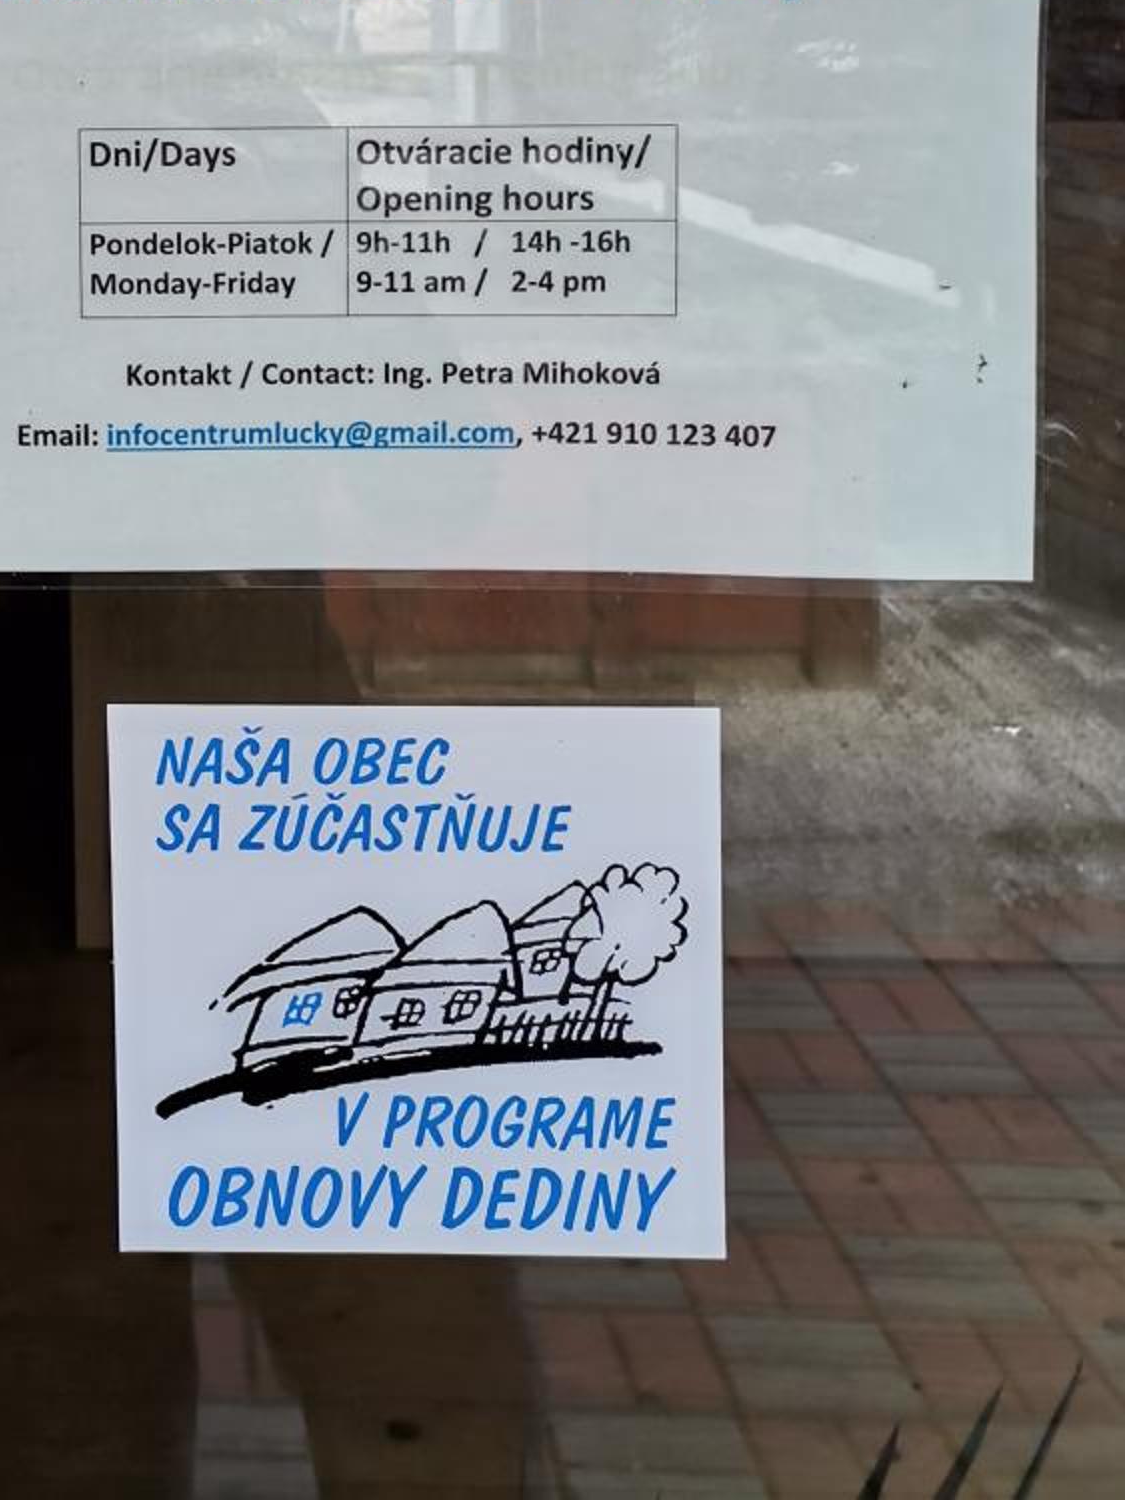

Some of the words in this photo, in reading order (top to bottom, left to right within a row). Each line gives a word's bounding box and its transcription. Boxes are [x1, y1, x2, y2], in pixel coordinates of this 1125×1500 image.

[89, 138, 236, 173] Dni/Days
[356, 137, 513, 167] Otváracie
[523, 134, 651, 171] hodiny/
[356, 185, 493, 218] Opening
[503, 182, 595, 211] hours
[89, 230, 313, 258] Pondelok-Piatok
[321, 230, 334, 259] /
[356, 229, 451, 255] 9h-11h
[475, 229, 487, 258] /
[511, 229, 562, 255] 14h
[570, 229, 631, 255] -16h
[89, 271, 296, 302] Monday-Friday
[356, 270, 414, 295] 9-11
[423, 276, 466, 295] am
[475, 269, 488, 298] /
[511, 269, 555, 294] 2-4
[564, 274, 607, 299] pm
[125, 362, 232, 388] Kontakt
[240, 362, 254, 391] /
[261, 362, 375, 388] Contact:
[384, 361, 432, 392] Ing.
[441, 362, 513, 387] Petra
[523, 360, 660, 387] Mihoková
[17, 423, 100, 449] Email:
[106, 421, 523, 453] infocentrumlucky@gmail.com,
[531, 422, 597, 446] +421
[606, 423, 657, 447] 910
[666, 423, 717, 447] 123
[724, 423, 777, 448] 407
[155, 726, 291, 787] NAŠA
[312, 736, 451, 786] OBEC
[155, 803, 221, 853] SA
[238, 792, 572, 854] ZÚČASTŇUJE
[336, 1091, 370, 1147] V
[382, 1094, 677, 1150] PROGRAME
[167, 1163, 428, 1229] OBNOVY
[441, 1165, 677, 1231] DEDINY
